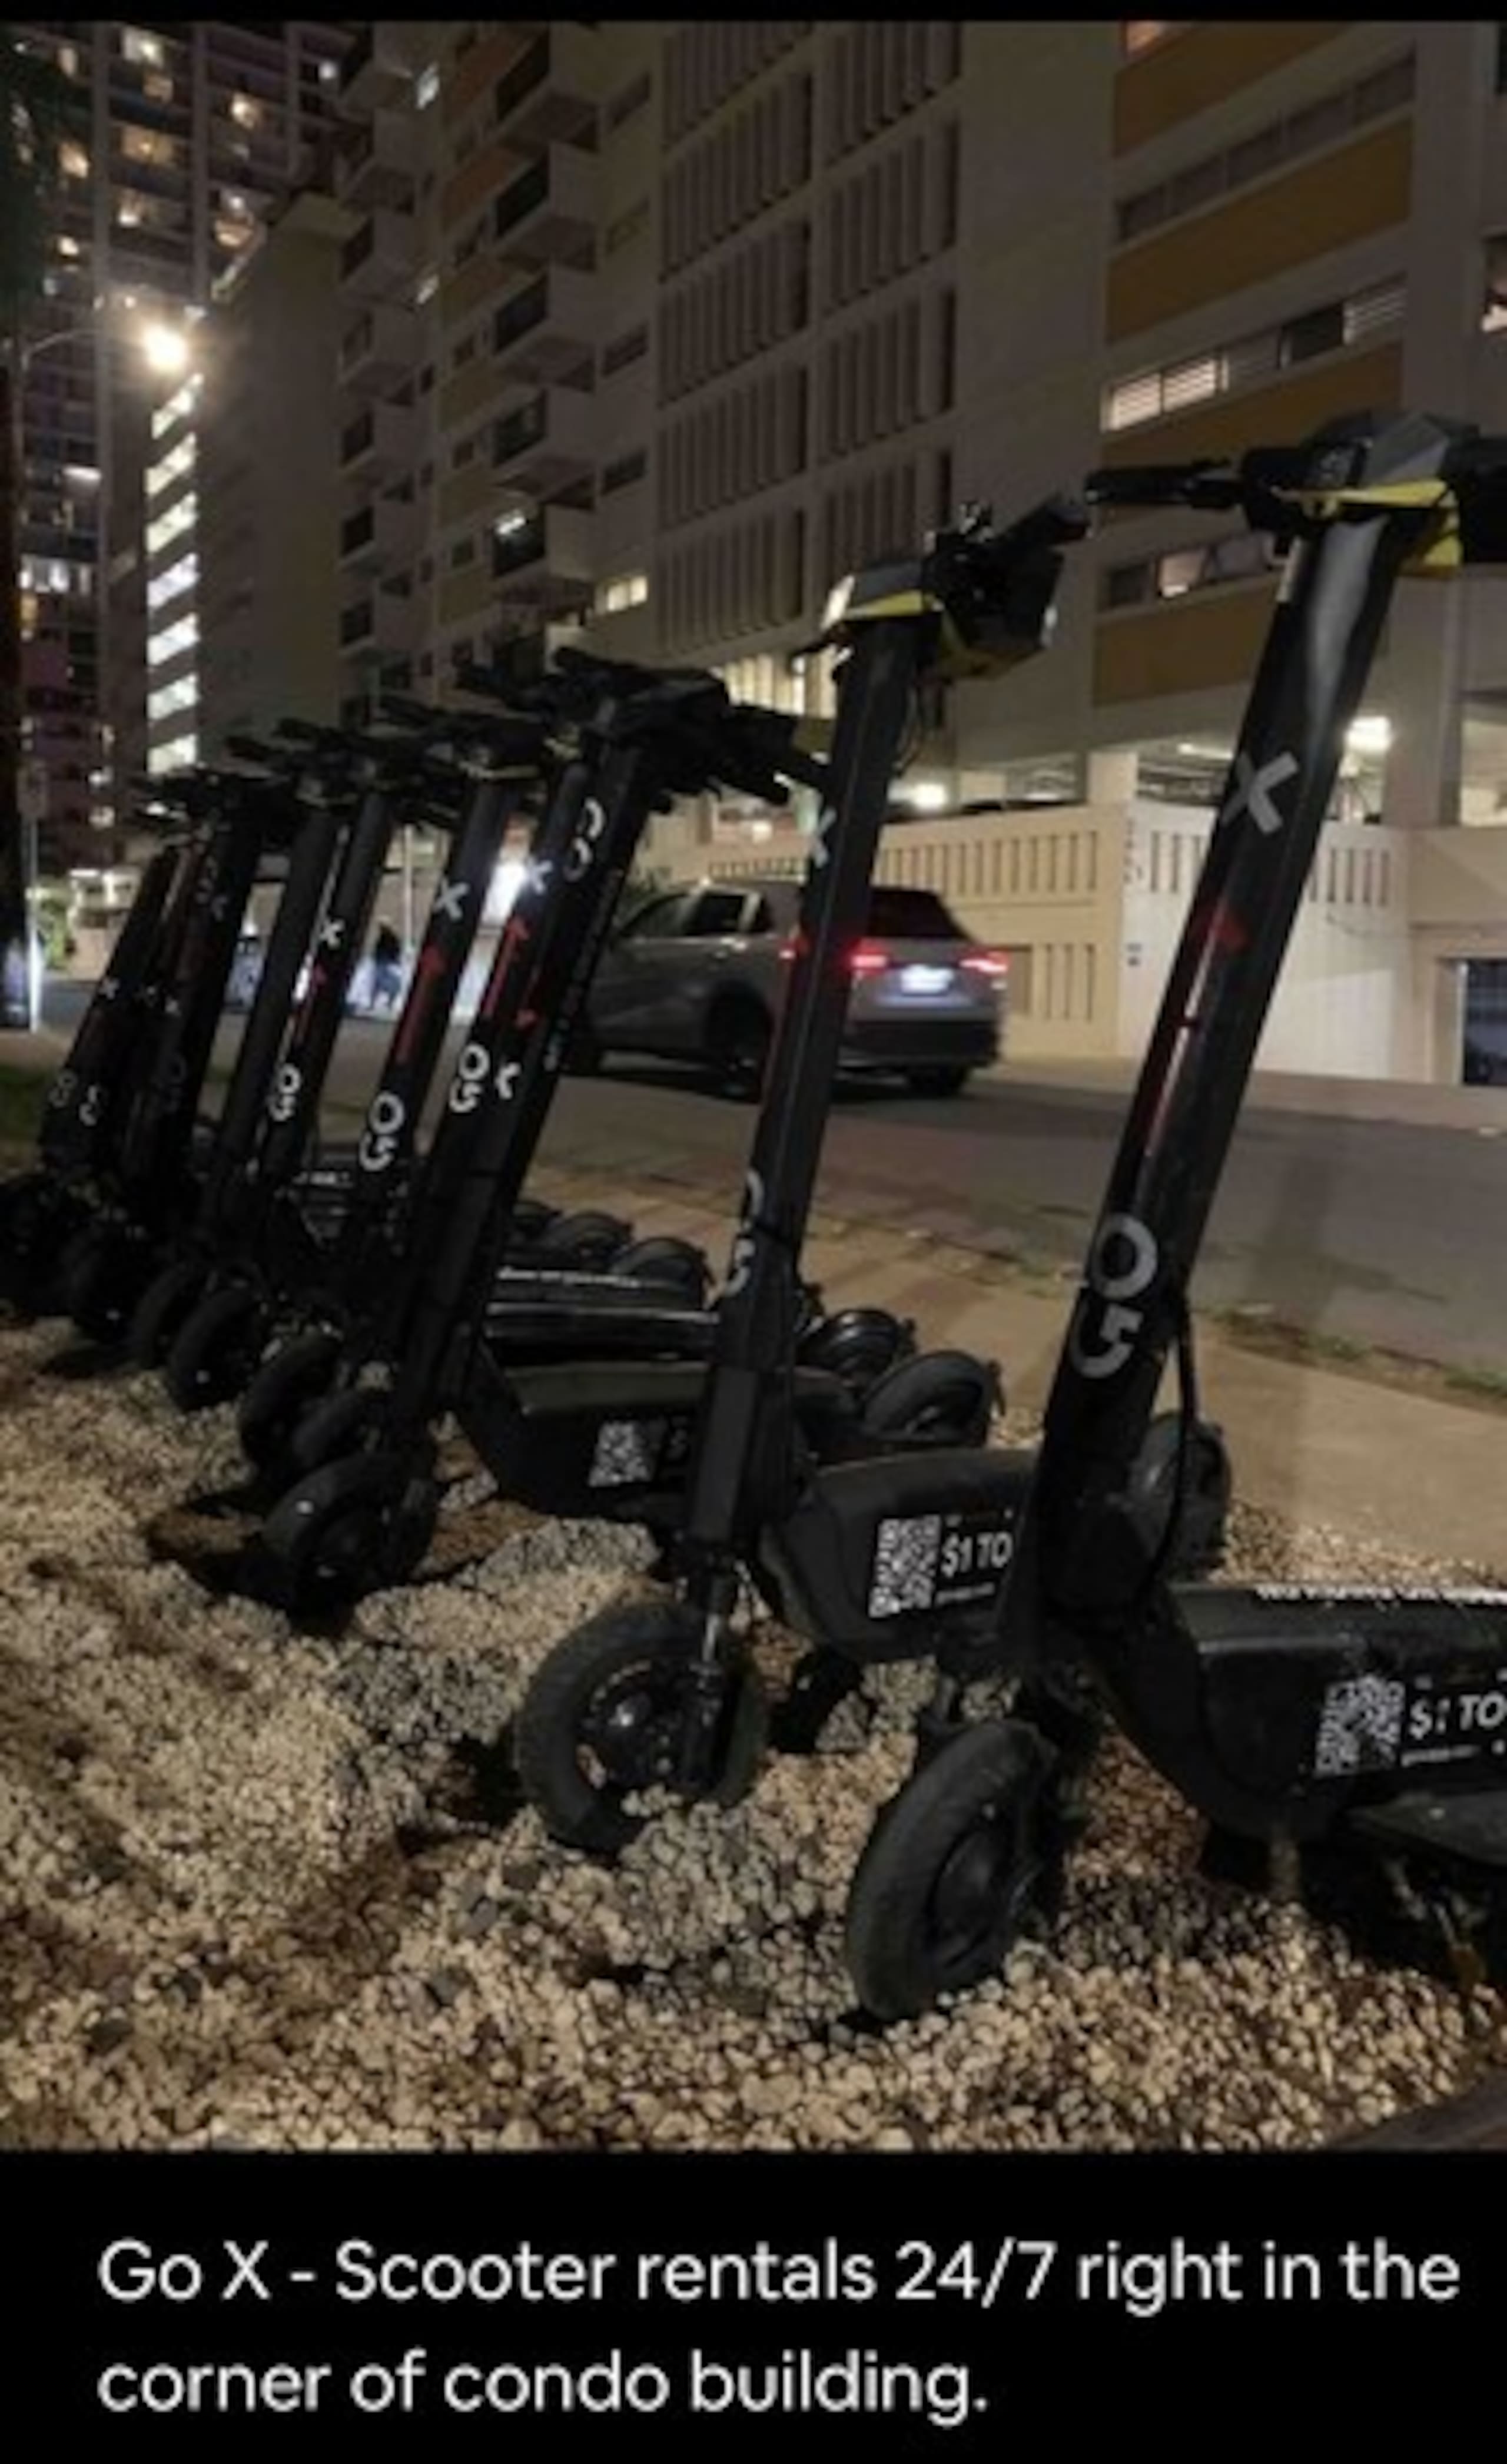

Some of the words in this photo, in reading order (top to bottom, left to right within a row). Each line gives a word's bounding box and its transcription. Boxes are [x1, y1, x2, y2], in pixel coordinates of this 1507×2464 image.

[268, 1063, 301, 1121] GO
[359, 1090, 404, 1171] GO
[433, 877, 469, 921] X
[449, 1044, 490, 1113] GO
[1068, 1212, 1159, 1379] GO
[1221, 751, 1297, 834] X
